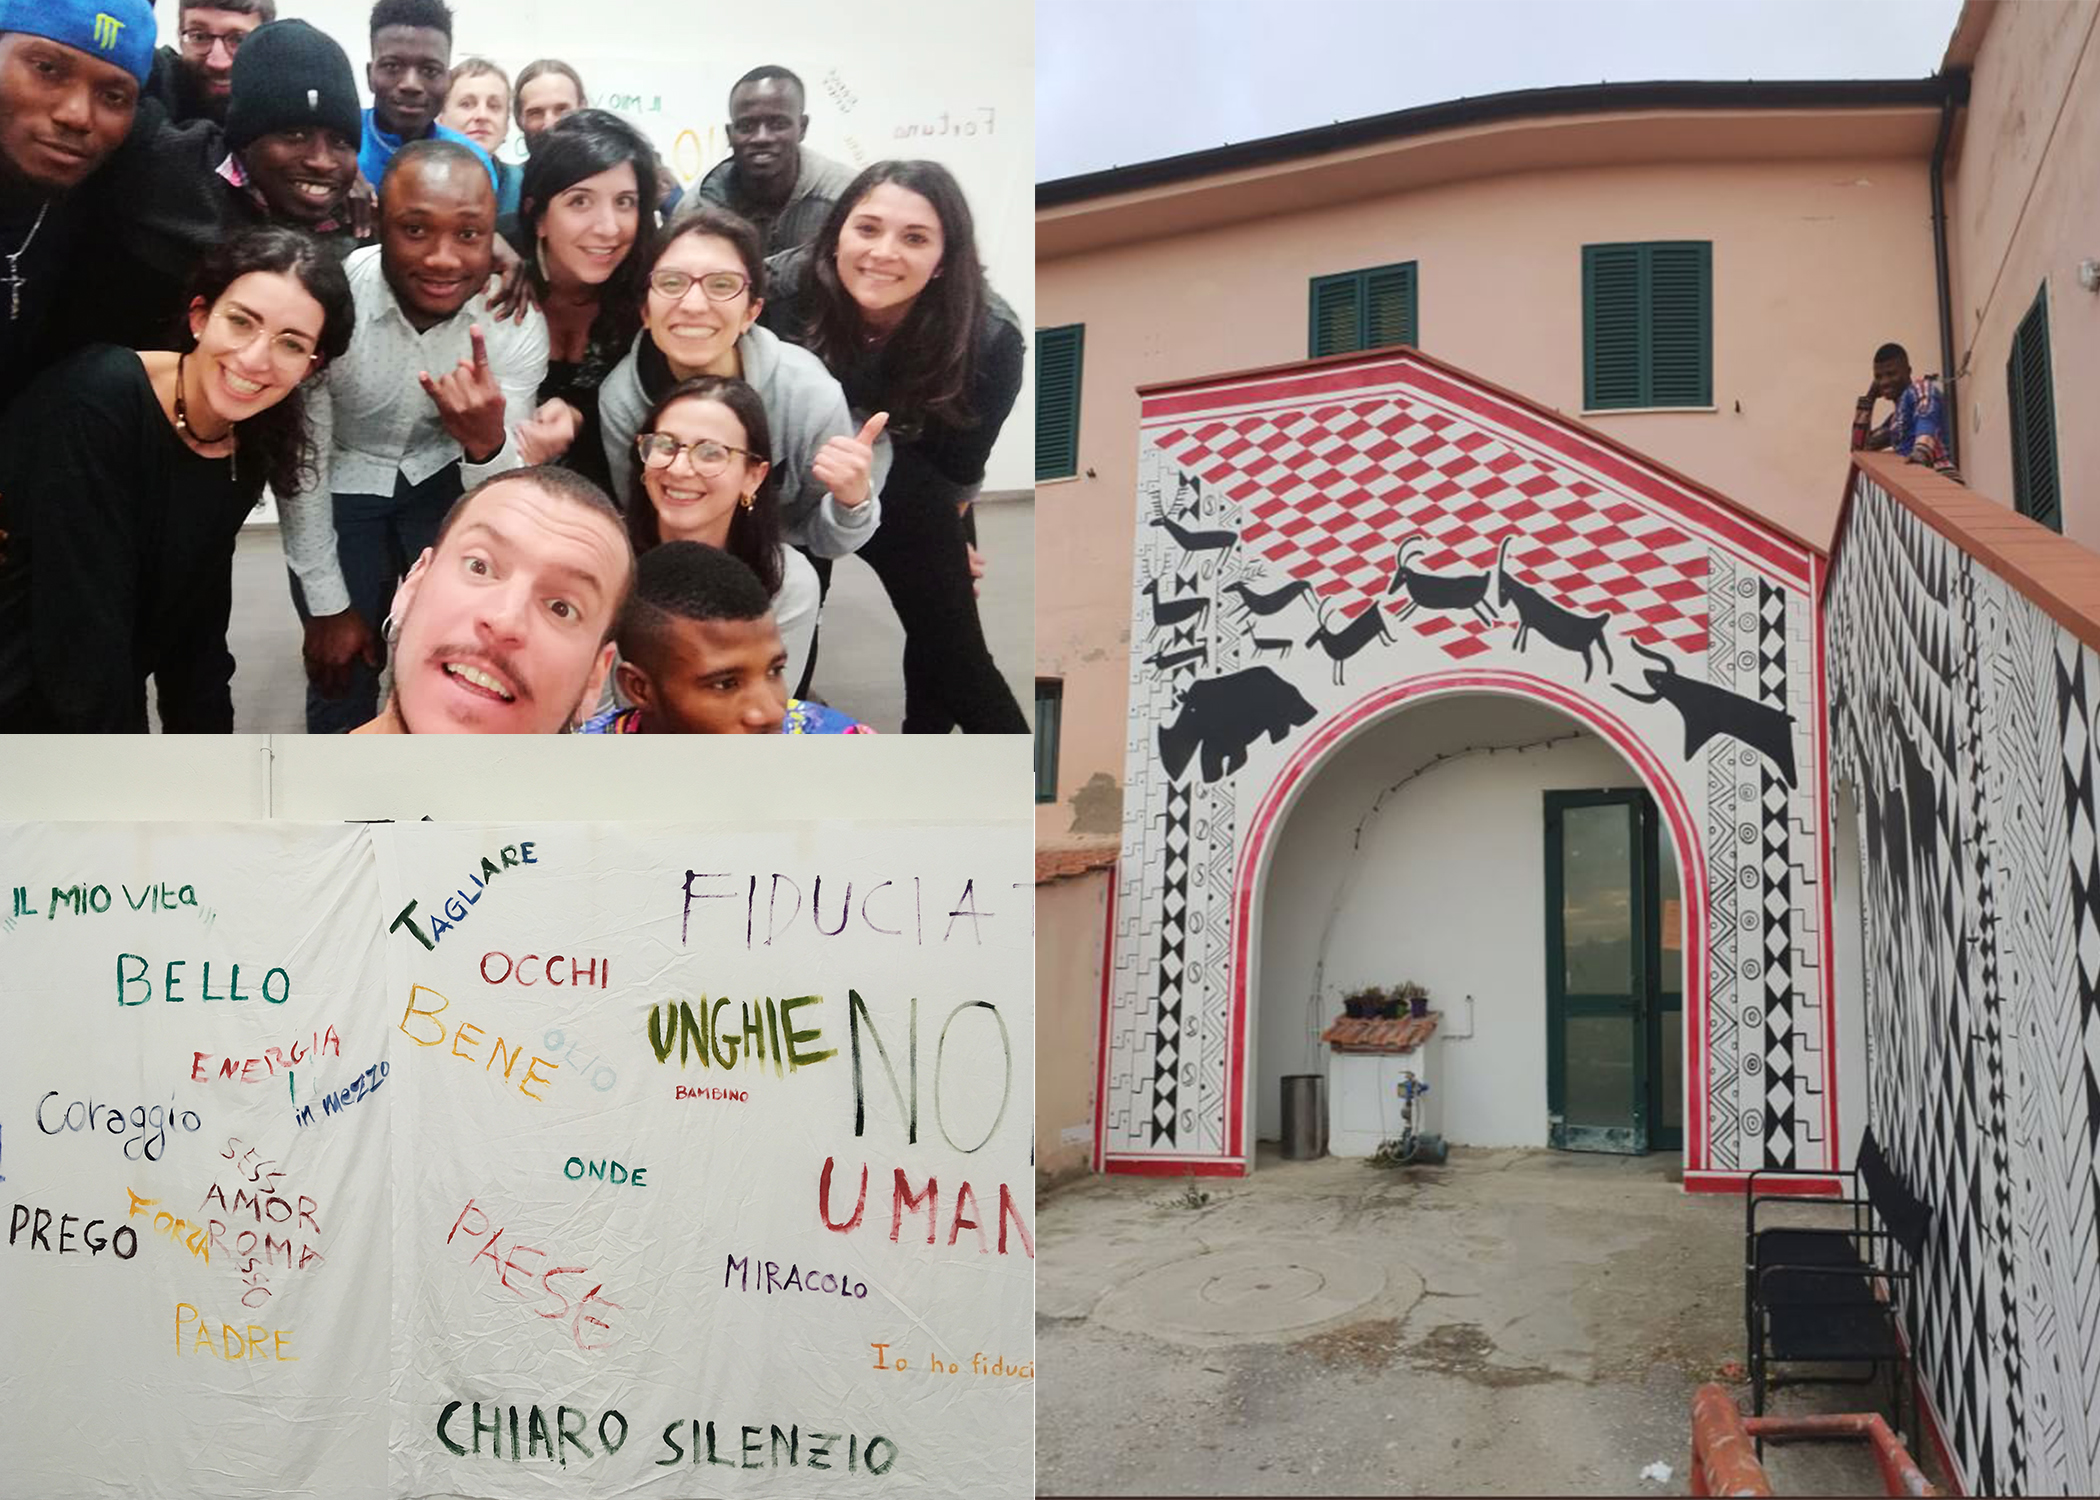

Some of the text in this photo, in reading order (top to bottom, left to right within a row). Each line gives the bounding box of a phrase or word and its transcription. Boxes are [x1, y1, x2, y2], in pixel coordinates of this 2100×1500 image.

[389, 841, 539, 951] TAGLIARE
[681, 869, 996, 951] FIDUCIA
[116, 952, 291, 1007] BELLO
[479, 950, 610, 990] OCCHI
[190, 1024, 341, 1085] ENERGIA
[397, 982, 560, 1103] BENE
[543, 1027, 618, 1093] OLIO
[647, 992, 839, 1080] UNGHIE
[675, 1084, 750, 1103] BAMBINO
[848, 988, 1013, 1154] NO
[563, 1156, 648, 1187] ONDE
[9, 1203, 138, 1260] PREGO
[198, 1180, 322, 1235] AMOR
[446, 1198, 625, 1351] PAESE
[724, 1253, 868, 1299] MIRACOLO
[174, 1302, 301, 1361] PADRE
[931, 1352, 959, 1374] ho
[436, 1400, 899, 1476] CHIARO SILENZIO
